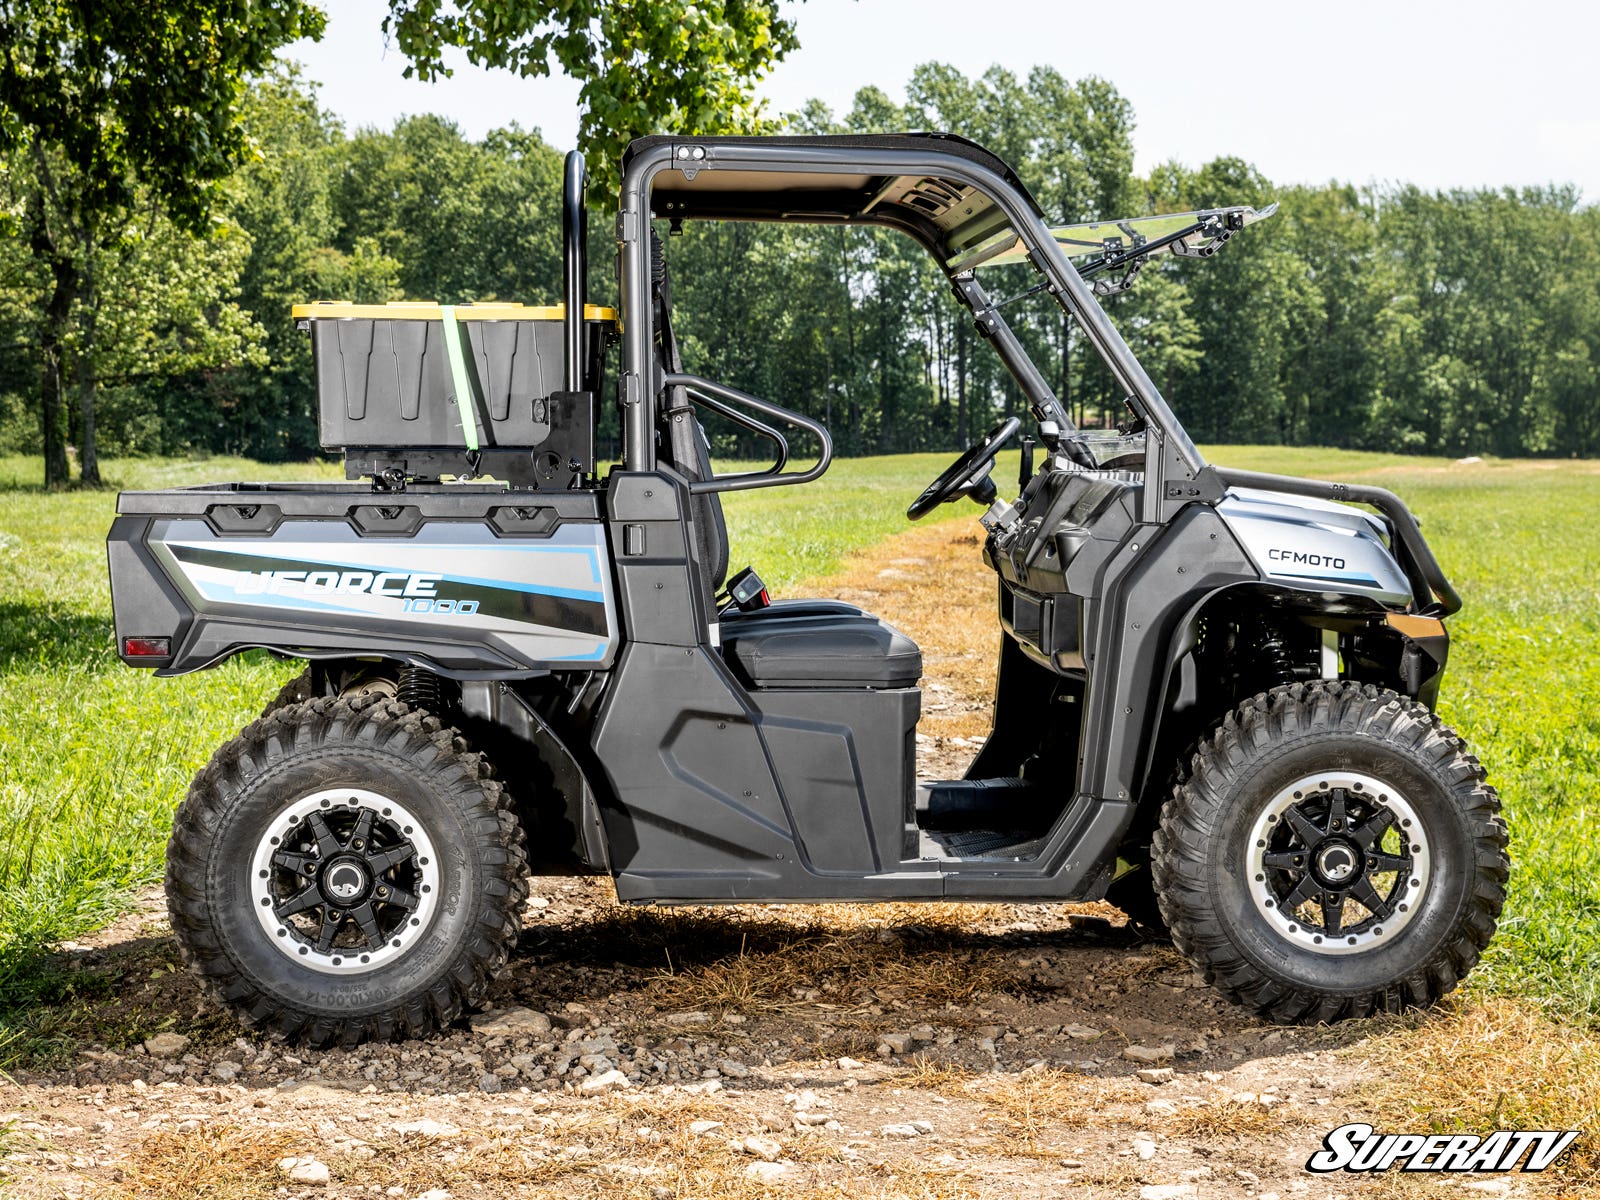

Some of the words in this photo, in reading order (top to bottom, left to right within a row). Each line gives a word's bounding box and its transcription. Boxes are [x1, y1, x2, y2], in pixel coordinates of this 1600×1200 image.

[1268, 548, 1346, 570] CFMOTO
[233, 570, 444, 598] UFORCE
[400, 598, 480, 616] 1000
